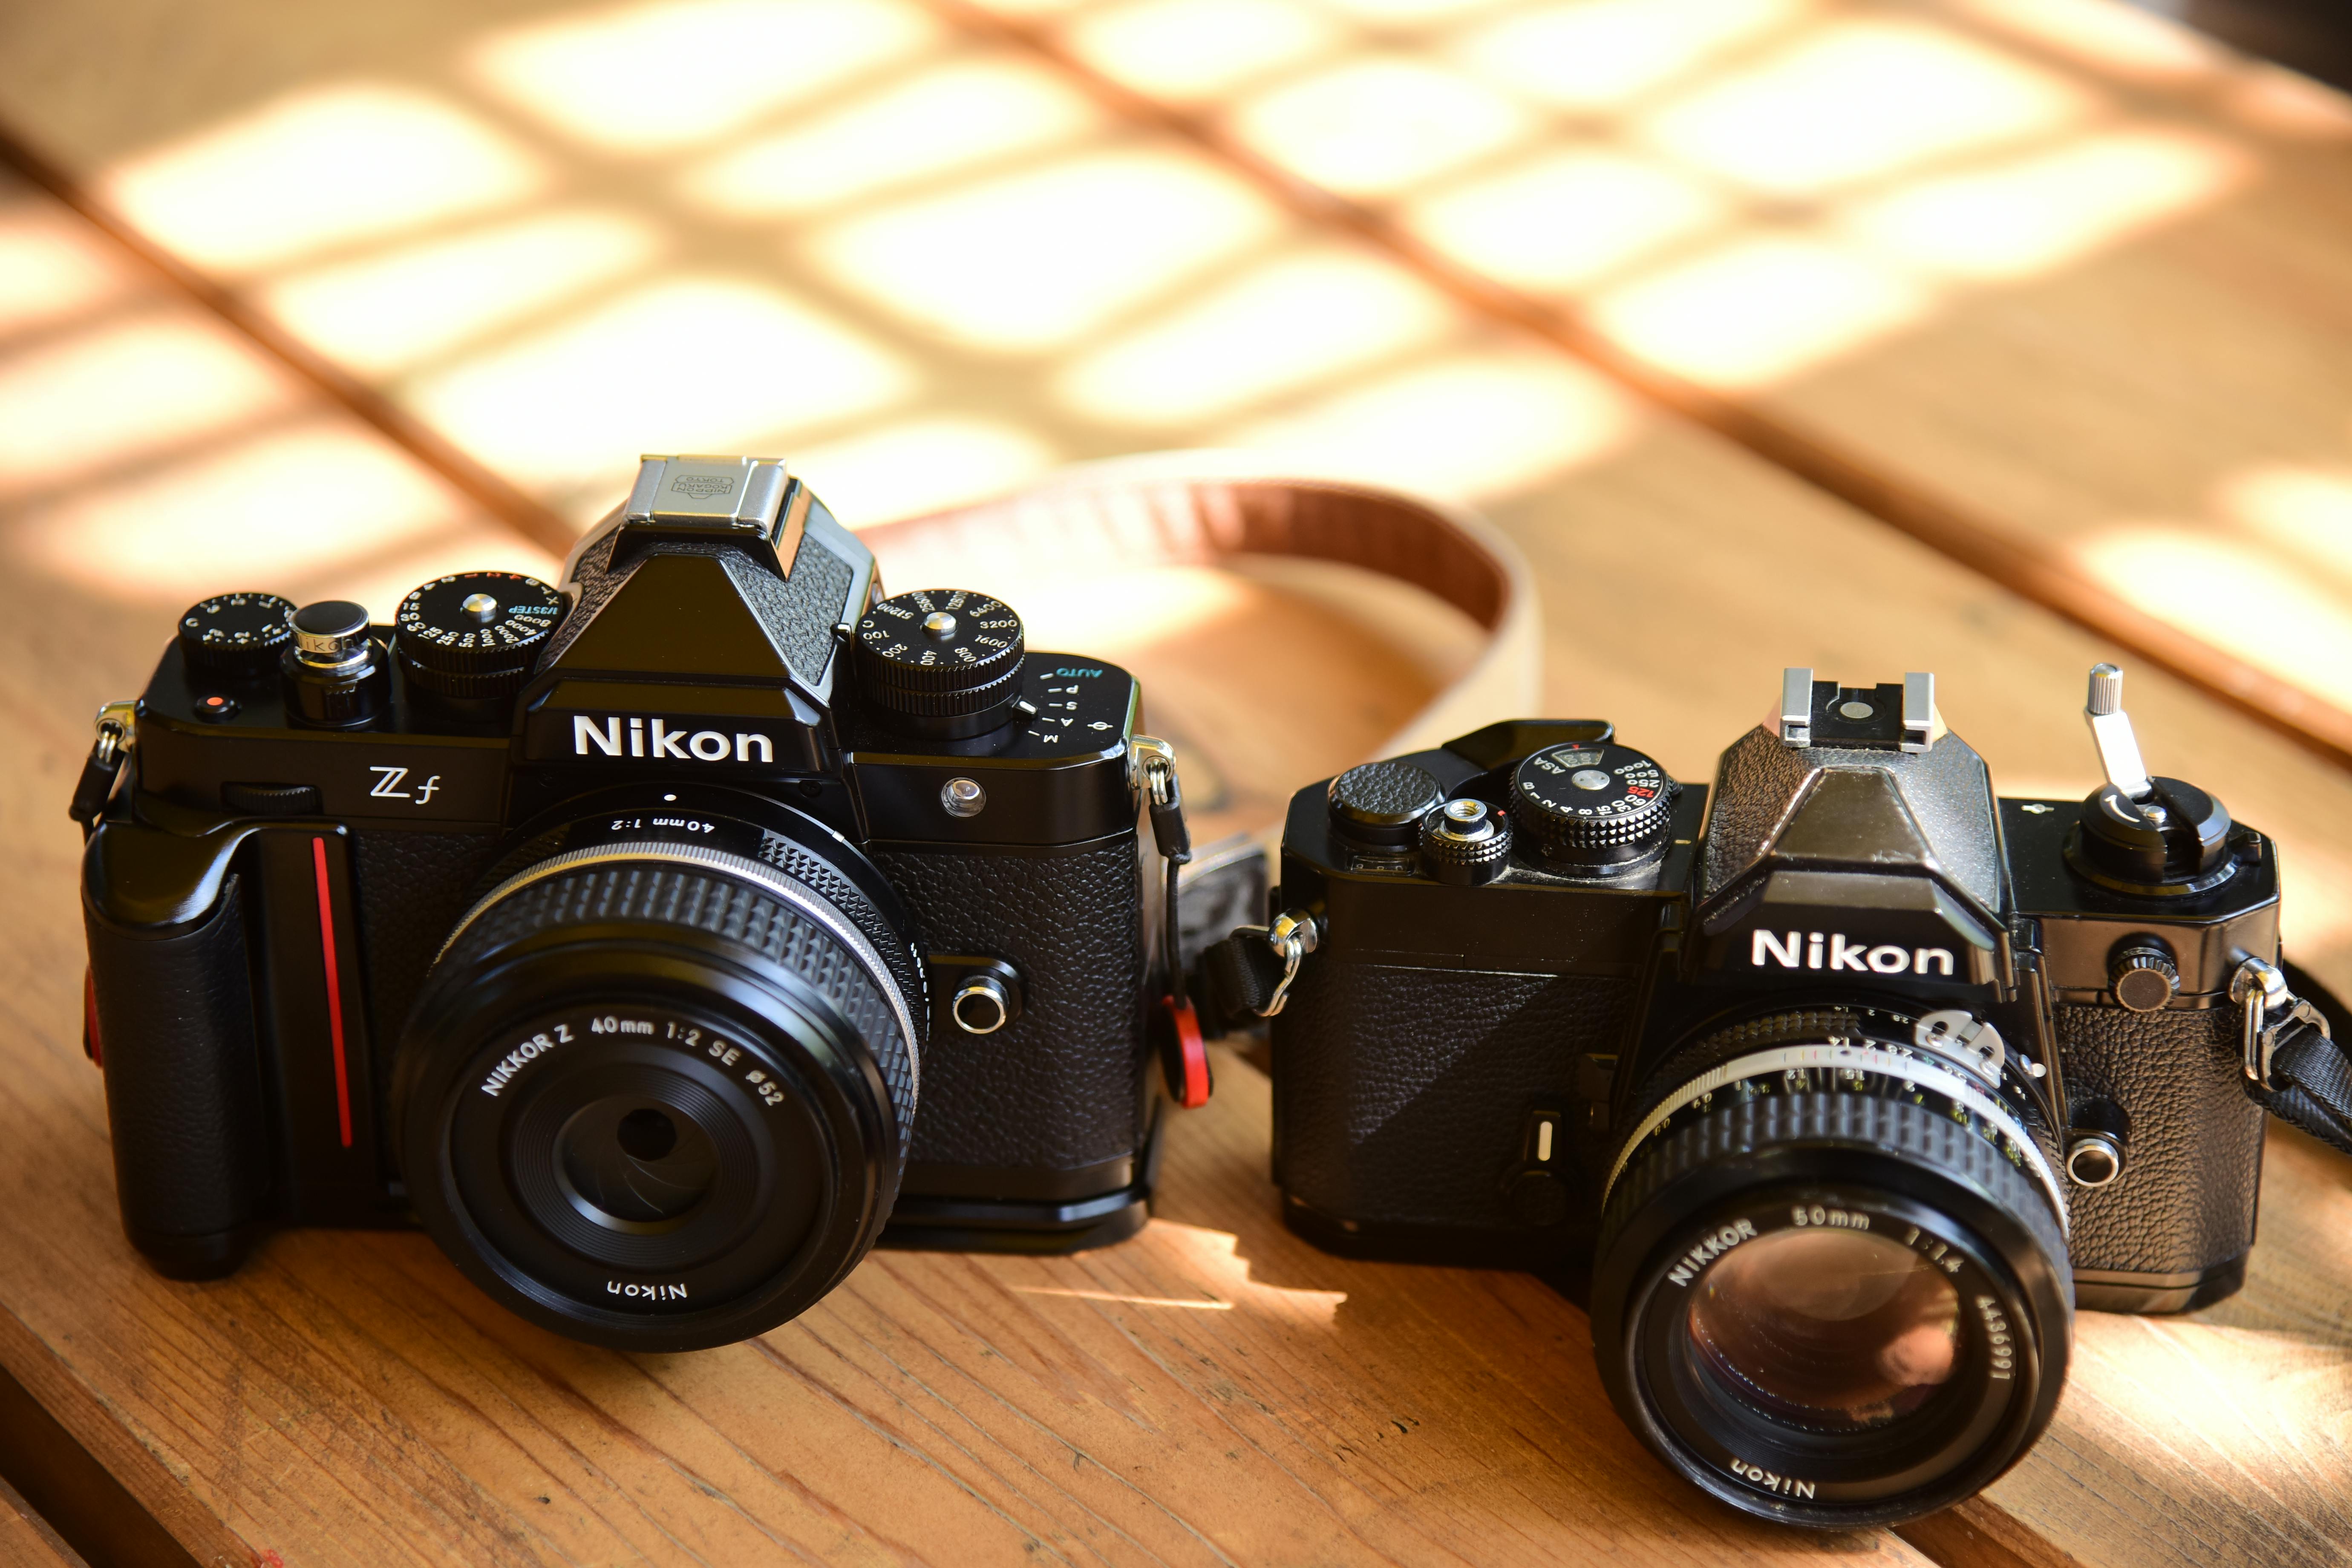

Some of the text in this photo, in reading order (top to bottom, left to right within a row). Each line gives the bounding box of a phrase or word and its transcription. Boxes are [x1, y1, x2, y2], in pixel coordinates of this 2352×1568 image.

[403, 602, 420, 611] 15
[546, 596, 559, 605] X
[911, 591, 935, 613] 25600
[945, 591, 968, 610] 12800
[876, 603, 914, 620] 51200
[970, 601, 1002, 617] 6400
[400, 612, 420, 622] 30
[514, 614, 552, 627] 8000
[407, 622, 426, 631] 60
[505, 620, 537, 636] 4000
[862, 620, 874, 628] C
[980, 619, 1017, 629] 3200
[418, 626, 443, 639] 125
[436, 631, 460, 646] 250
[480, 628, 496, 647] 1000
[494, 625, 520, 643] 2000
[863, 630, 890, 640] 100
[458, 632, 476, 648] 500
[974, 634, 1008, 649] 1600
[882, 643, 908, 657] 200
[954, 647, 977, 662] 800
[920, 650, 937, 666] 400
[1056, 667, 1103, 678] AUTO
[1066, 685, 1078, 694] P
[1066, 701, 1078, 710] S
[1061, 718, 1073, 726] A
[574, 715, 773, 763] Nikon
[1043, 735, 1058, 743] M
[1533, 757, 1565, 775] ASA
[1614, 760, 1652, 775] 1000
[1624, 769, 1659, 779] 500
[1522, 781, 1535, 790] B
[1626, 779, 1660, 788] 250
[1627, 786, 1655, 798] 125
[1541, 799, 1556, 808] 2
[1611, 800, 1631, 812] 30
[1624, 795, 1646, 806] 60
[1559, 805, 1573, 813] 4
[1596, 805, 1612, 816] 15
[611, 817, 715, 833] 40mm 1:2
[1752, 929, 1954, 975] Nikon
[481, 1033, 555, 1097] NIKKOR
[553, 1023, 575, 1043] Z
[591, 1016, 654, 1035] 40mm
[667, 1021, 701, 1047] 1:2
[708, 1040, 741, 1066] SE
[1668, 1205, 1965, 1287] NIKKOR 50mm 1:1.4
[607, 1280, 687, 1301] Nikon
[1730, 1458, 1816, 1499] Nikon
